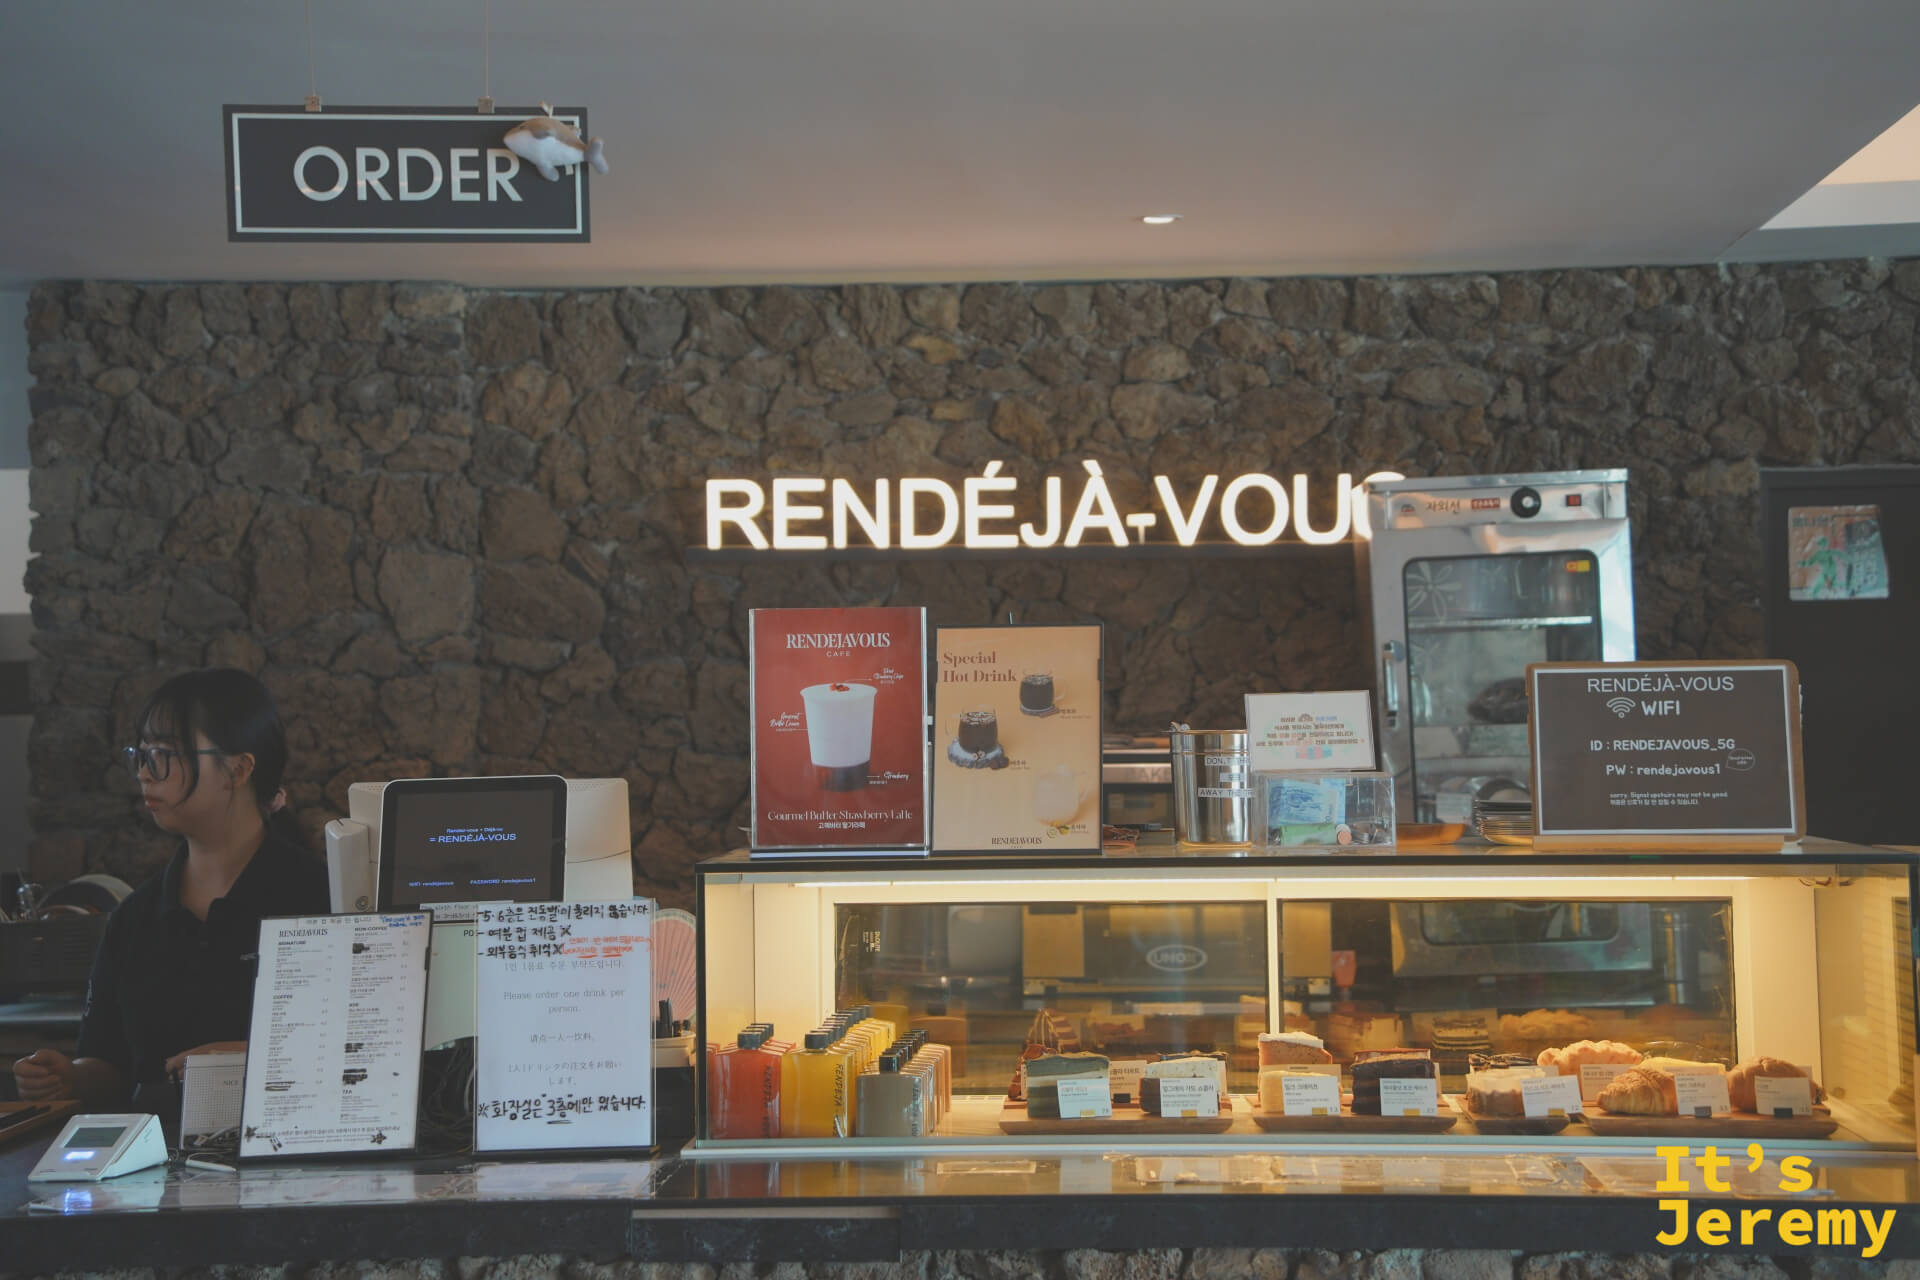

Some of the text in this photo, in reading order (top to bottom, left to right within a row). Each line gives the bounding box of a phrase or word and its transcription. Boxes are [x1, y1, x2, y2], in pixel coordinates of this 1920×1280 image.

[294, 146, 523, 201] ORDER
[785, 632, 892, 649] RENDEJAVOUS
[943, 651, 996, 667] Special
[943, 669, 1017, 682] Hot Drink
[1587, 673, 1735, 693] RENDÉJÀ-VOUS
[1641, 699, 1681, 716] WIFI
[1613, 738, 1735, 752] RENDEJAVOUS_5G
[1606, 764, 1626, 776] PW
[1636, 763, 1721, 776] rendejavous1
[438, 832, 517, 844] RENDÉJÀ-VOUS
[504, 988, 624, 1000] Please order one drink per
